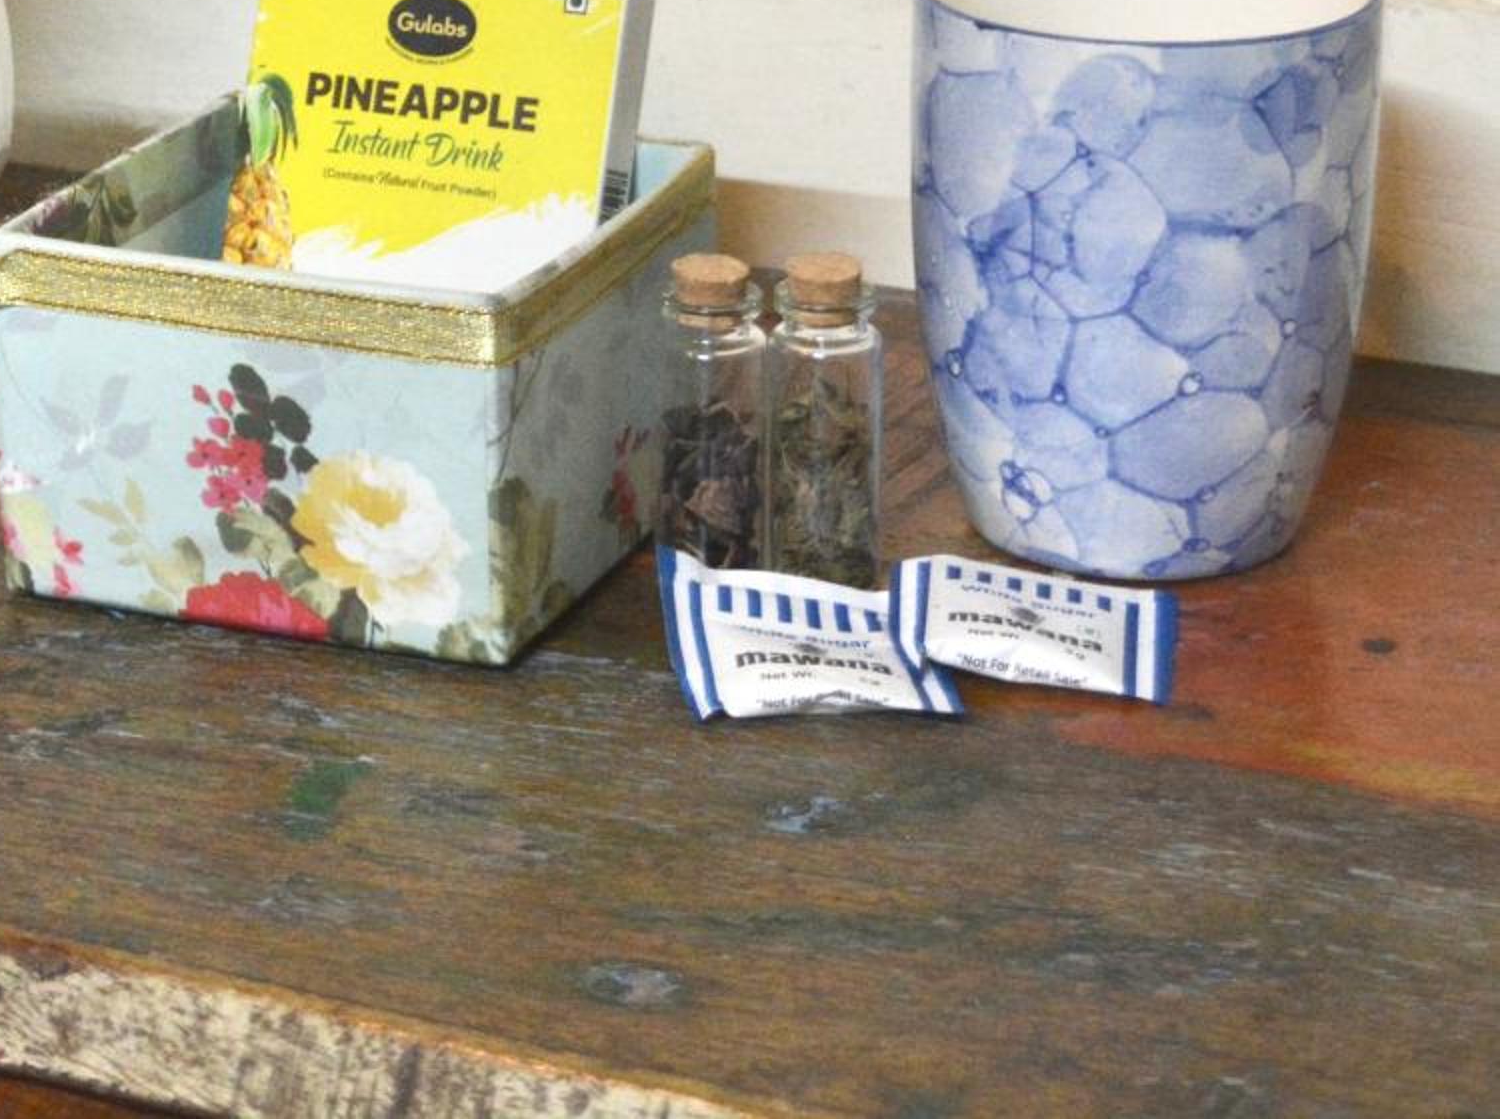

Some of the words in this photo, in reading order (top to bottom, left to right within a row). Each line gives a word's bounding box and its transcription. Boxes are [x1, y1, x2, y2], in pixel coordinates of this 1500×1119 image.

[396, 12, 468, 39] Gulabs
[305, 71, 540, 132] PINEAPPLE
[326, 119, 421, 161] Instant
[424, 131, 503, 172] Drink
[947, 611, 1103, 653] mawana
[735, 651, 893, 676] mawana
